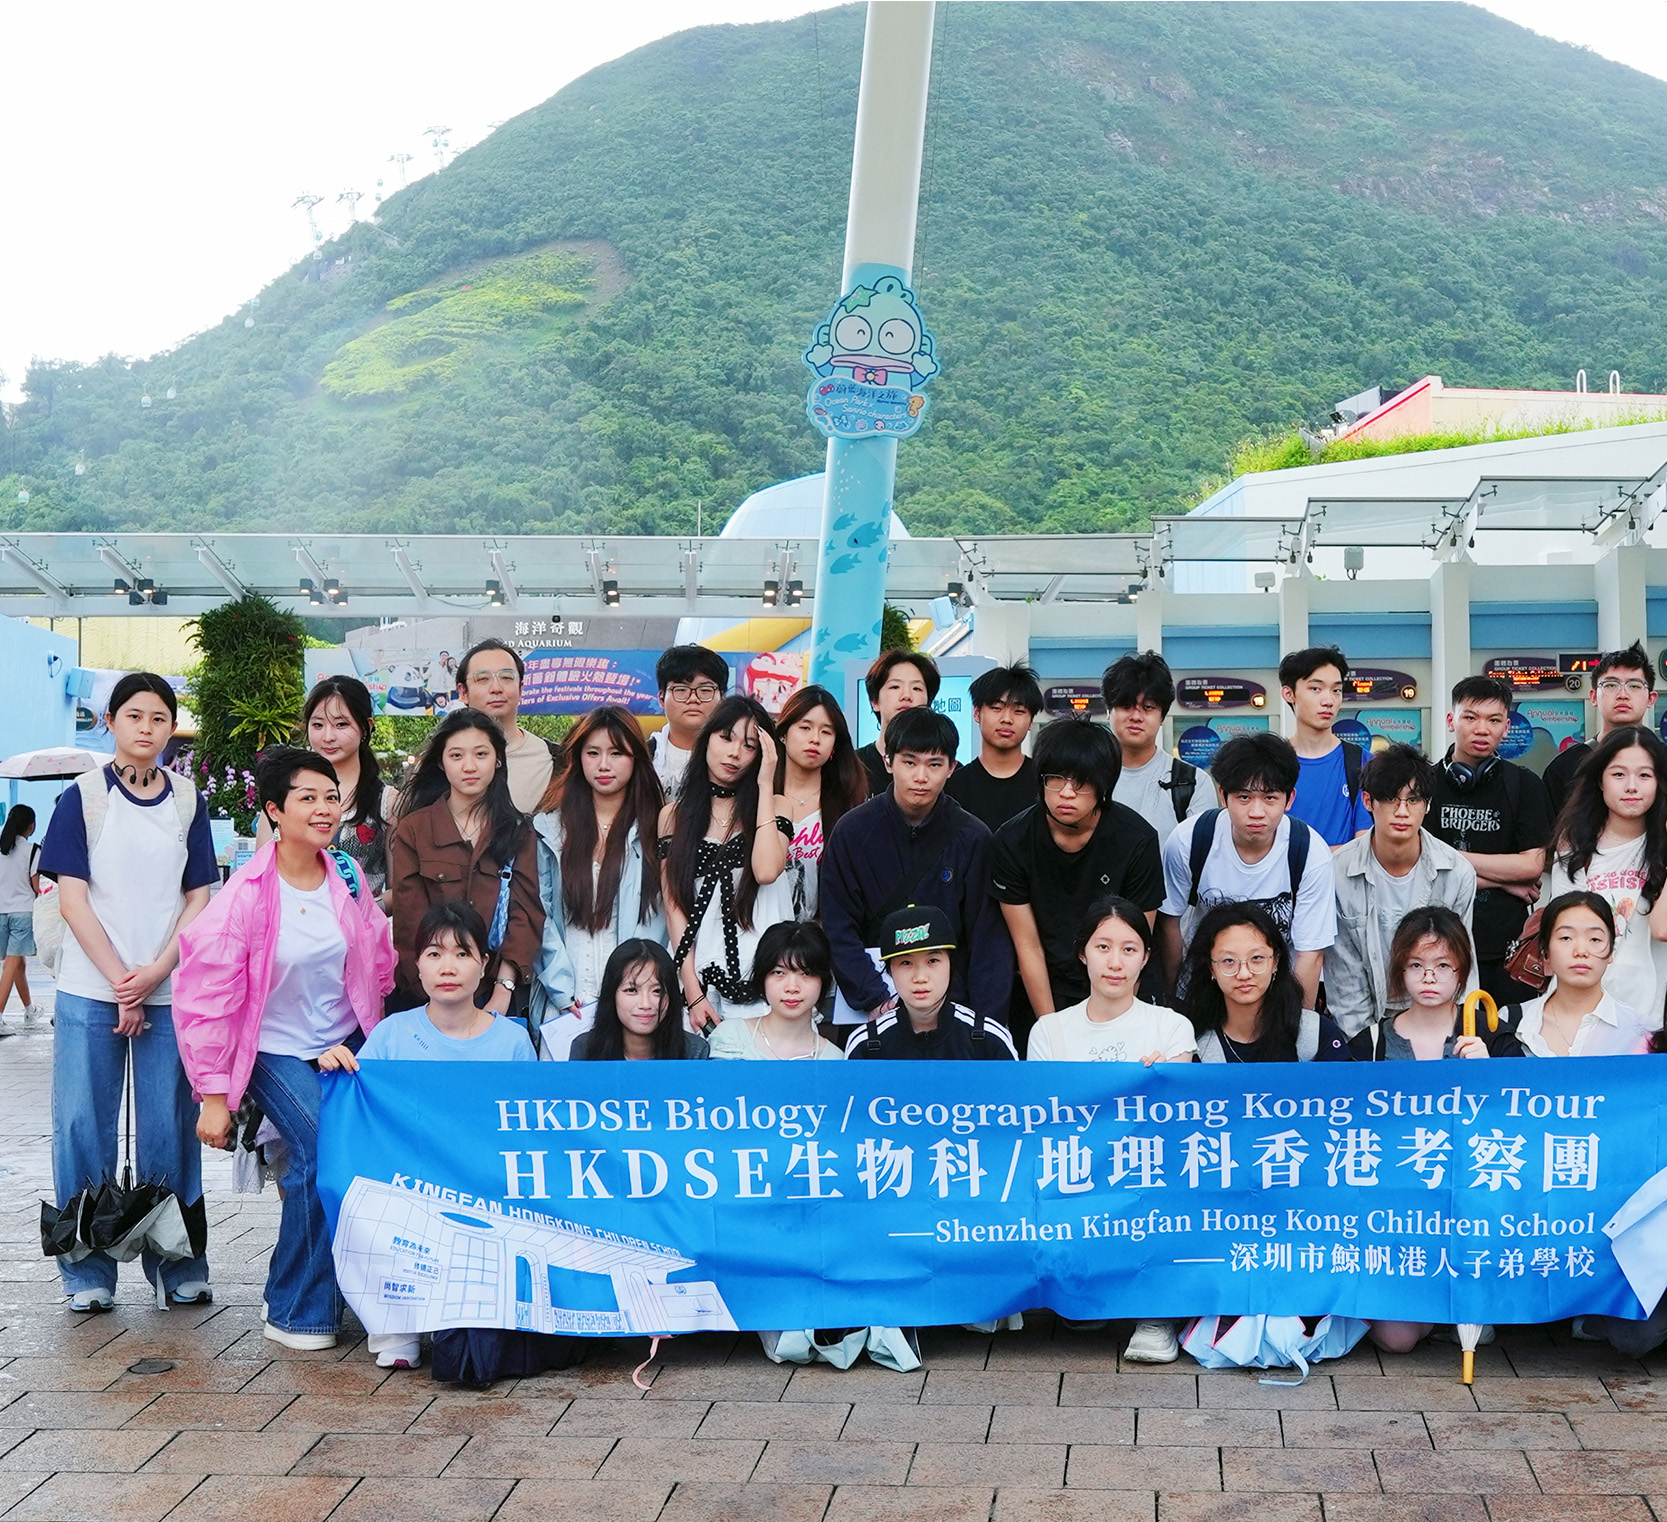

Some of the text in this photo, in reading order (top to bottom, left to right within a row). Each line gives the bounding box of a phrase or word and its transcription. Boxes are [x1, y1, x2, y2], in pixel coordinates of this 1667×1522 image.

[825, 396, 849, 408] Ocean
[851, 395, 868, 407] Park
[842, 403, 867, 416] Sanrio
[515, 621, 584, 636] 海洋奇觀
[518, 639, 573, 649] AQUARIUM
[1568, 679, 1580, 688] 20
[546, 694, 580, 702] Exclusive
[581, 693, 605, 702] Offers
[553, 685, 582, 693] festivals
[584, 686, 622, 695] throughout
[624, 688, 635, 697] the
[1403, 688, 1414, 698] 19
[1441, 806, 1494, 821] PHOEBE
[1441, 817, 1501, 832] BRIDGERS
[895, 922, 931, 946] PIZZA!
[495, 1086, 1605, 1138] HKDSE Biology / Geography Hong Kong Study Tour
[391, 1172, 682, 1258] KINGFAN HONGKONG CHILDREN SCHOOL
[1081, 1208, 1192, 1241] Kingfan
[1201, 1208, 1276, 1237] Hong
[1285, 1208, 1359, 1237] Kong
[1366, 1208, 1491, 1237] Children
[1499, 1212, 1595, 1238] School
